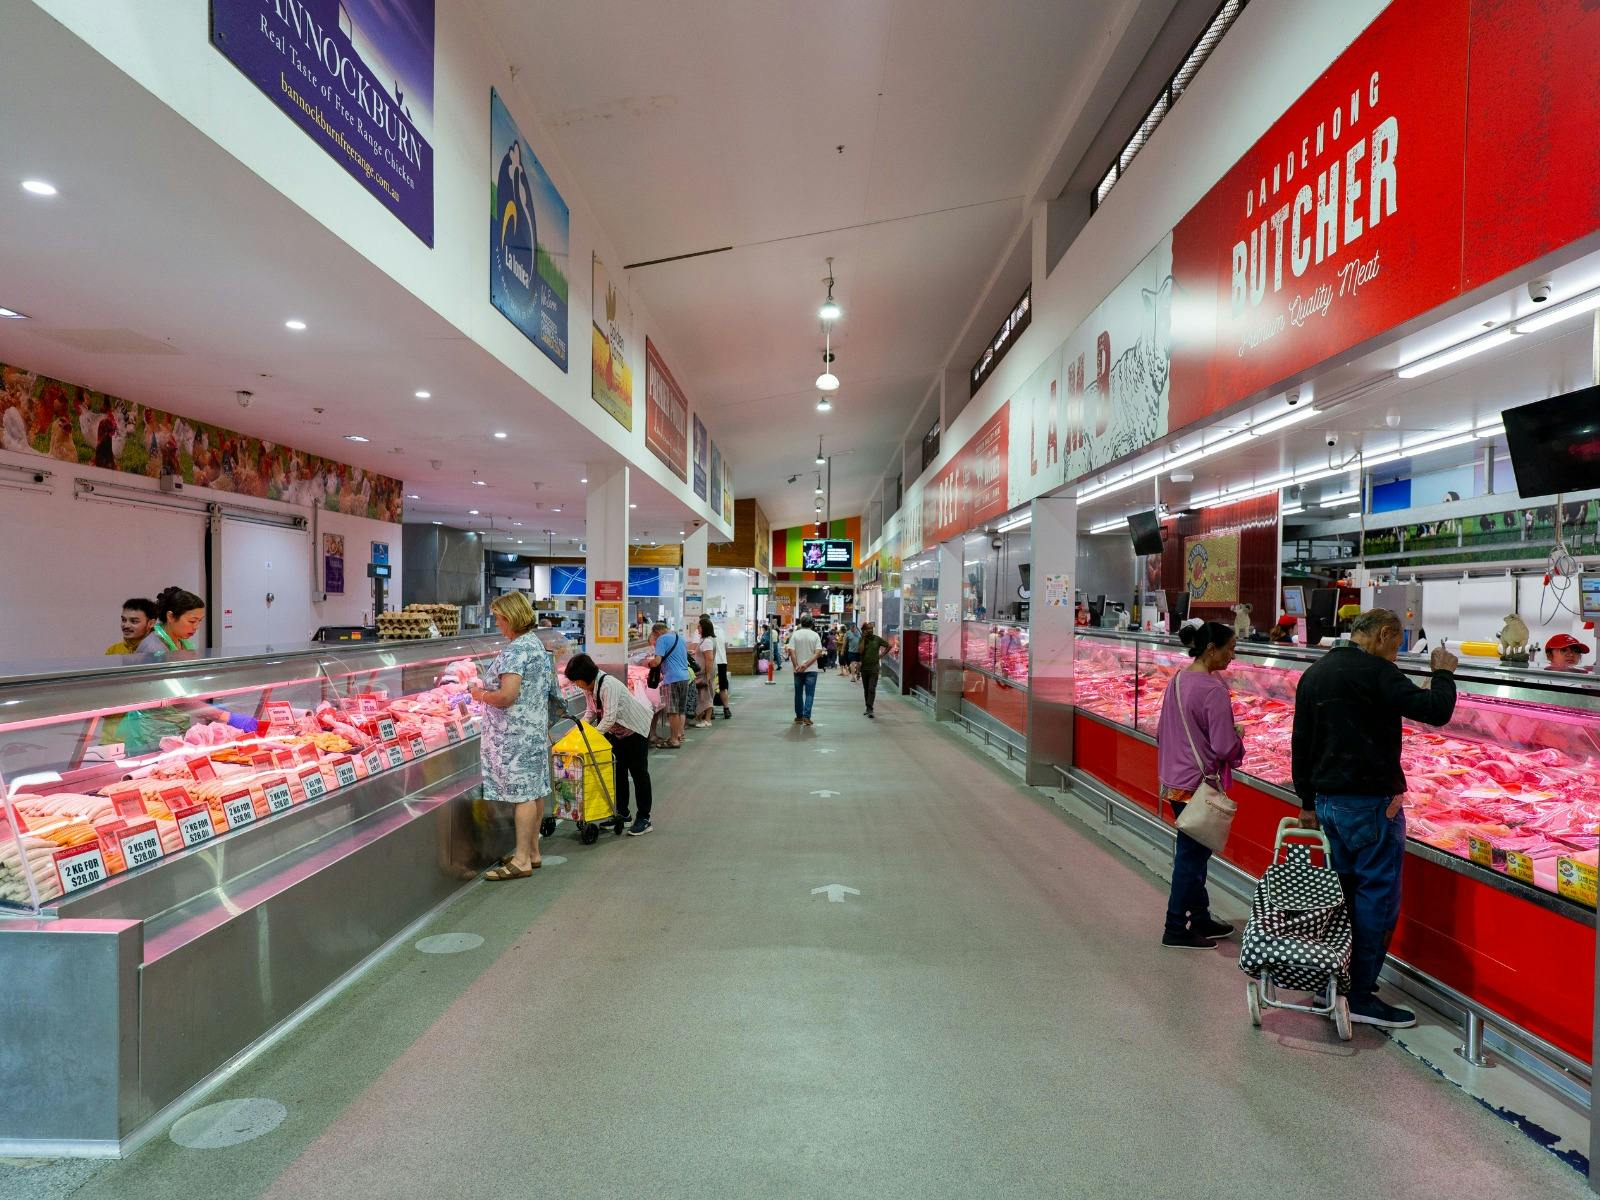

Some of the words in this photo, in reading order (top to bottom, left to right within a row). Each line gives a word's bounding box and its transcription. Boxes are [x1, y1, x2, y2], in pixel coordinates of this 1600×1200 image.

[260, 13, 286, 55] Real
[290, 44, 318, 88] Taste
[321, 85, 333, 102] of
[335, 94, 354, 126] Free
[357, 117, 382, 156] Range
[385, 148, 415, 190] Chicken
[281, 71, 400, 203] bannockburnfreerange.com.au
[1246, 71, 1379, 218] DANDENONG
[1231, 116, 1399, 321] BUTCHER
[1288, 295, 1333, 327] Quality
[1337, 250, 1380, 297] Meat
[1030, 331, 1111, 477] LAMB
[128, 845, 134, 854] 2
[134, 841, 144, 851] KG
[144, 837, 157, 849] FOR
[189, 822, 198, 832] KG
[198, 818, 209, 828] FOR
[189, 829, 210, 843] $28.00
[65, 866, 72, 877] 2
[71, 862, 84, 875] KG
[83, 858, 100, 871] FOR
[71, 870, 100, 888] $28.00
[133, 849, 157, 865] $28.00
